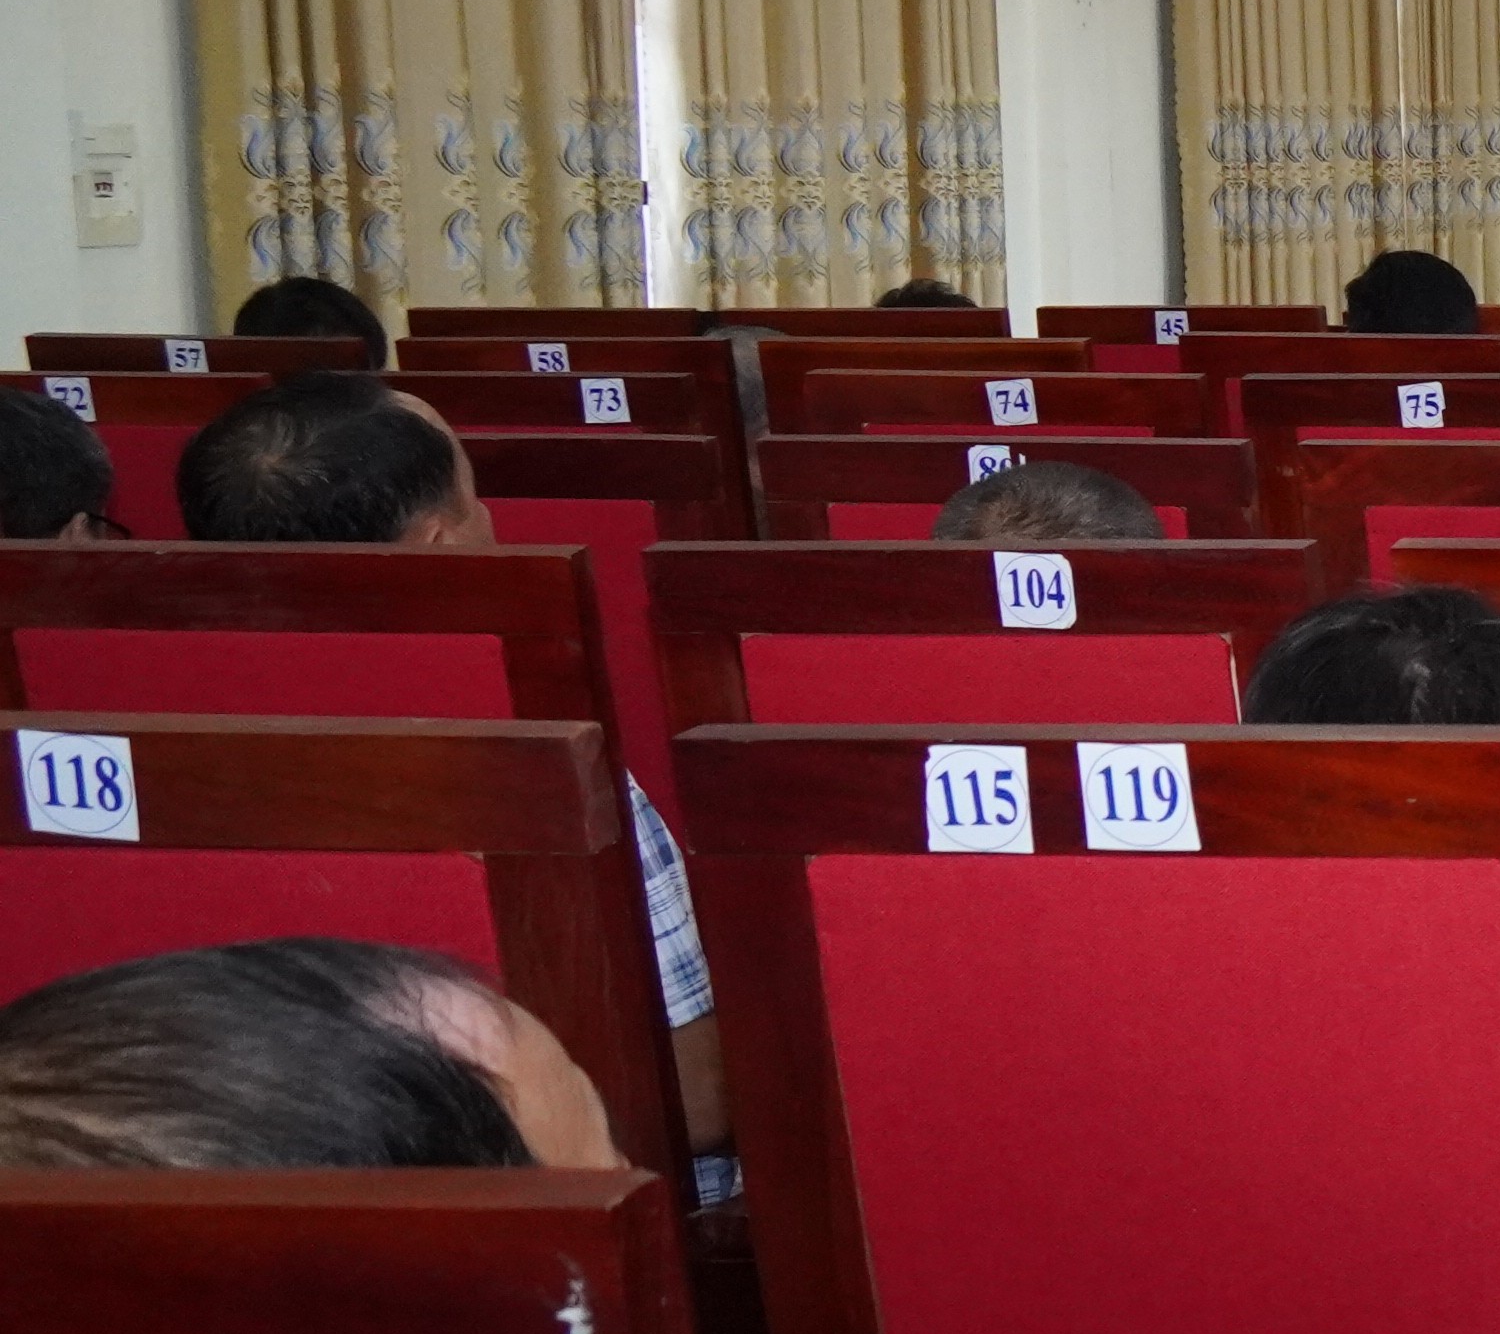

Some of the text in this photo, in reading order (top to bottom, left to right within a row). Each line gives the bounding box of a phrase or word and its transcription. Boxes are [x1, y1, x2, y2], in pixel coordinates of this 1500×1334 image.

[1160, 318, 1184, 338] 45
[173, 346, 202, 369] 57
[537, 351, 565, 370] 58
[53, 386, 86, 411] 72
[589, 387, 622, 412] 73
[995, 388, 1030, 415] 74
[1405, 392, 1440, 419] 75
[1008, 568, 1066, 610] 104
[38, 752, 123, 812] 118
[1098, 765, 1178, 823] 119
[936, 769, 1018, 827] 115
